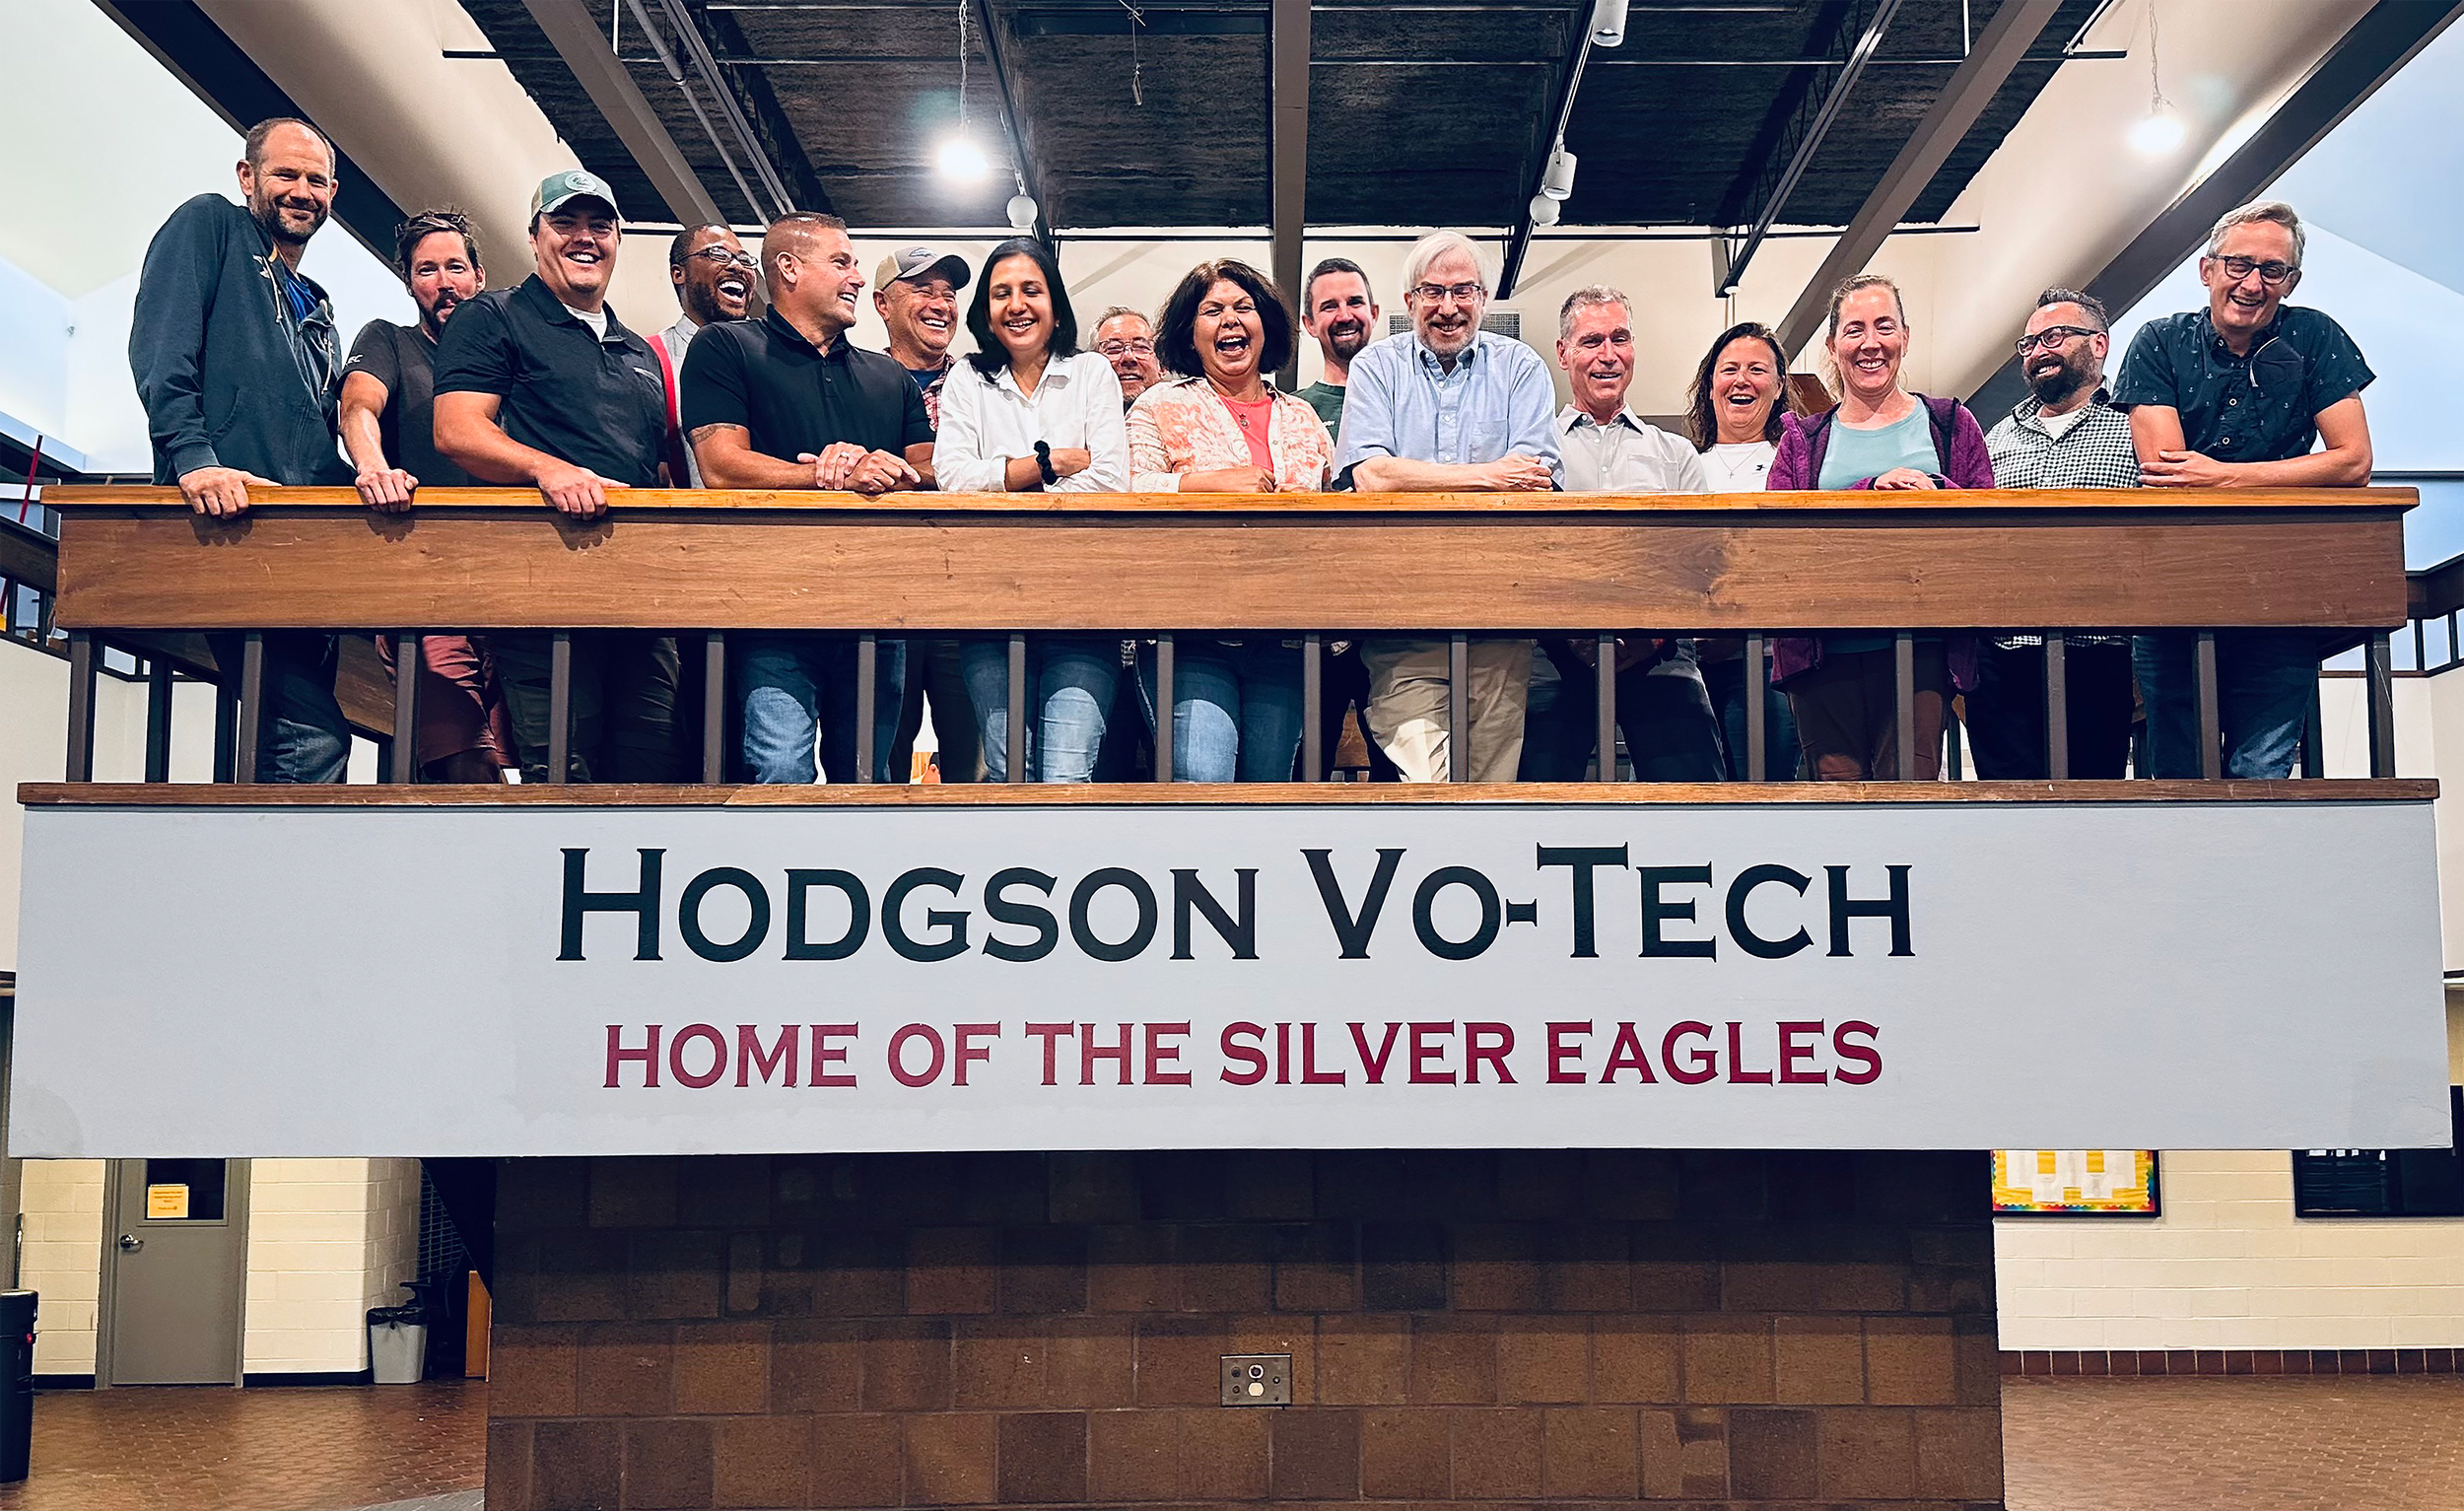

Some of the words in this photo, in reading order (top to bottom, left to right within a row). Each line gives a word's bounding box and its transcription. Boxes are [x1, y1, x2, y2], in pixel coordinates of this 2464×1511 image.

[556, 848, 1260, 962] HODGSON
[1300, 842, 1915, 962] VO-TECH
[603, 1022, 858, 1088] HOME
[888, 1021, 1000, 1087] OF
[1025, 1020, 1192, 1088] THE
[1220, 1019, 1518, 1087] SILVER
[1545, 1018, 1882, 1087] EAGLES
